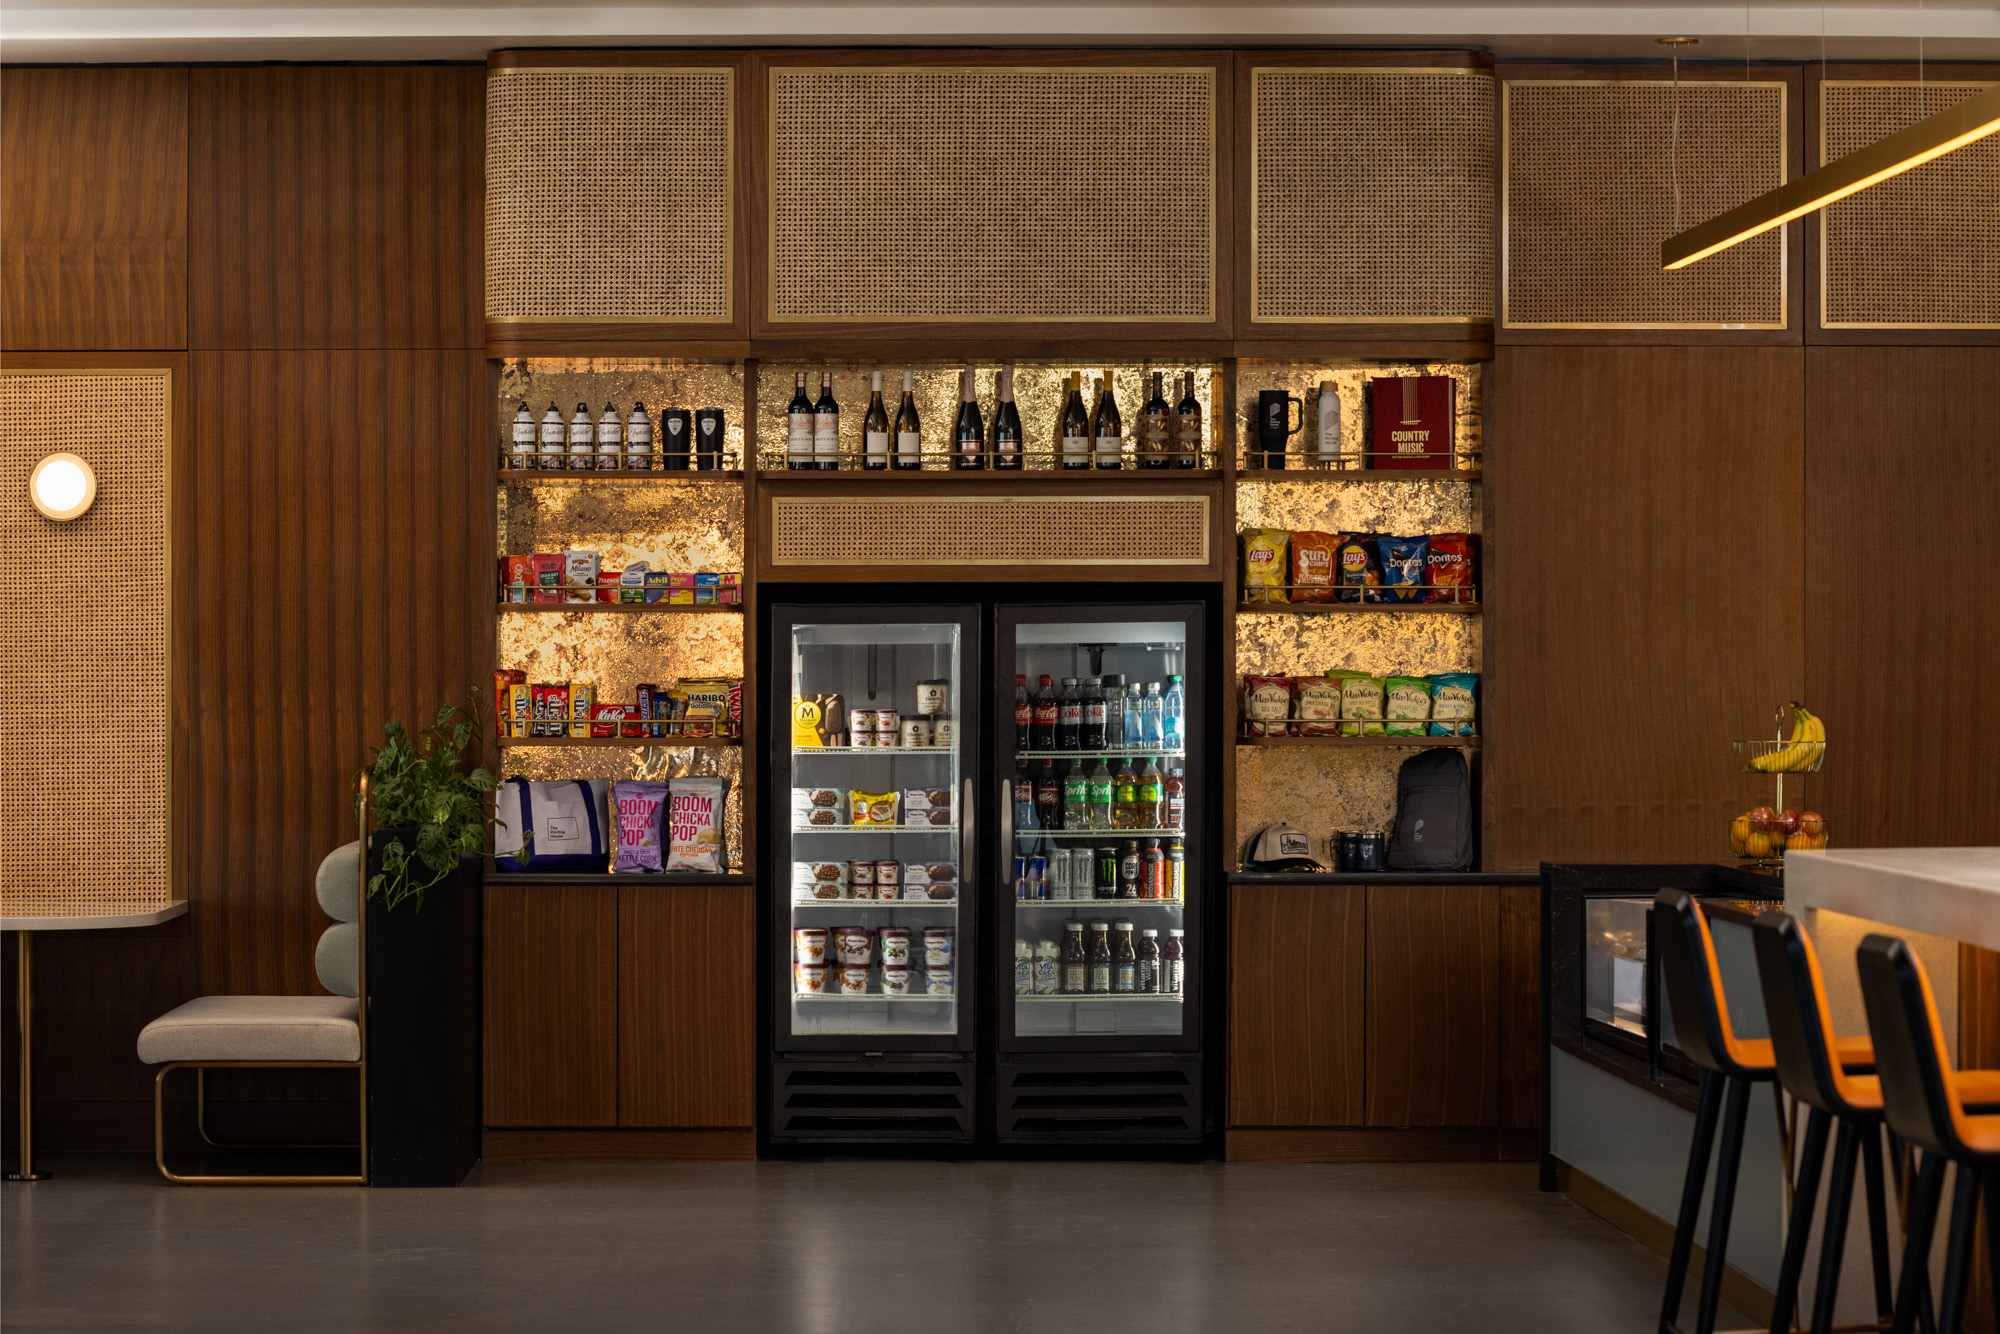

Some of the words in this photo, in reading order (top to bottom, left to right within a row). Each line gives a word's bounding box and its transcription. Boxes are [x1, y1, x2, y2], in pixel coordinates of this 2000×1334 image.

[1391, 430, 1430, 441] COUNTRY
[1397, 442, 1424, 453] MUSIC
[1249, 550, 1274, 562] Lay's
[1298, 549, 1330, 567] Sun
[1343, 551, 1366, 565] Lay's
[1427, 554, 1463, 565] Doritos
[1389, 558, 1423, 568] Doritos
[570, 565, 592, 573] Milano
[647, 576, 668, 584] Advil
[687, 694, 726, 702] HARIBO
[1253, 693, 1270, 703] Miss
[1303, 690, 1320, 698] Miss
[1343, 689, 1361, 699] Miss
[1389, 691, 1406, 700] Miss
[1404, 691, 1427, 706] Vickie's
[1438, 692, 1455, 701] Miss
[690, 702, 723, 710] Goldbears
[801, 707, 815, 719] M
[1086, 707, 1104, 718] oke
[620, 799, 659, 815] BOOM
[674, 796, 712, 813] BOOM
[620, 816, 655, 828] CHICKA
[672, 811, 711, 826] CHICKA
[620, 829, 644, 846] POP
[671, 825, 698, 841] POP
[618, 854, 638, 862] KETTLE
[1172, 861, 1180, 898] BODYARMOR
[1126, 883, 1137, 894] 26
